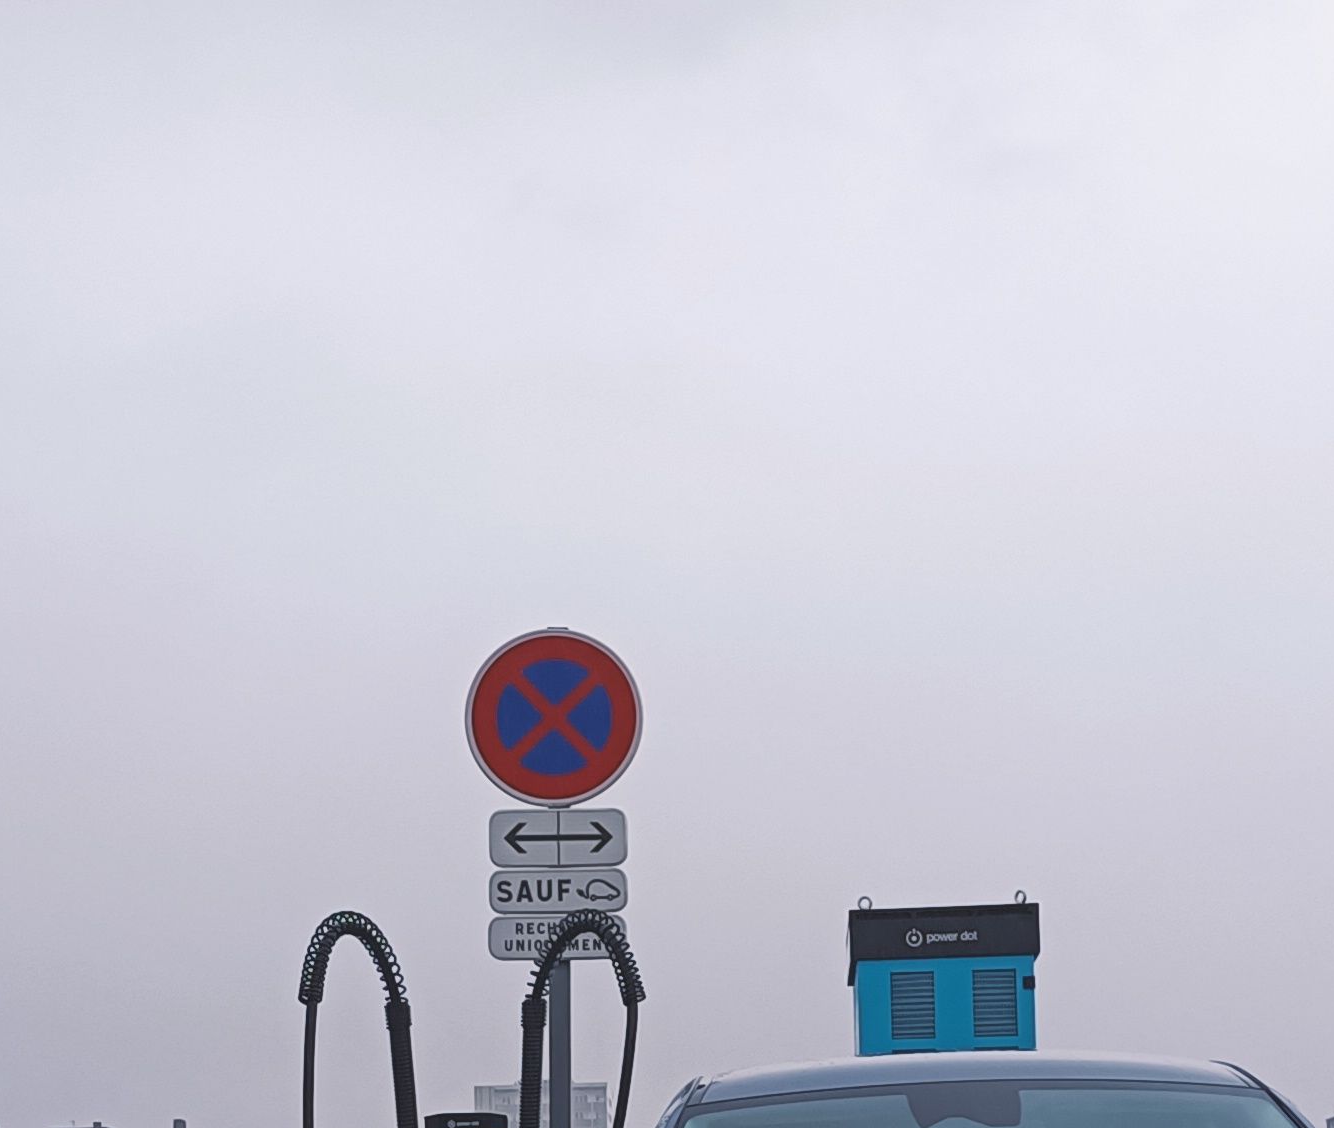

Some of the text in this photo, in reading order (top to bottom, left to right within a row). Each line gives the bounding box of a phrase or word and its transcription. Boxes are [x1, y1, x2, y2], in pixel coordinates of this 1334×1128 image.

[496, 878, 572, 903] SAUF
[515, 922, 578, 935] RECH
[926, 930, 978, 945] power dot
[504, 938, 607, 952] UNIQMEN
